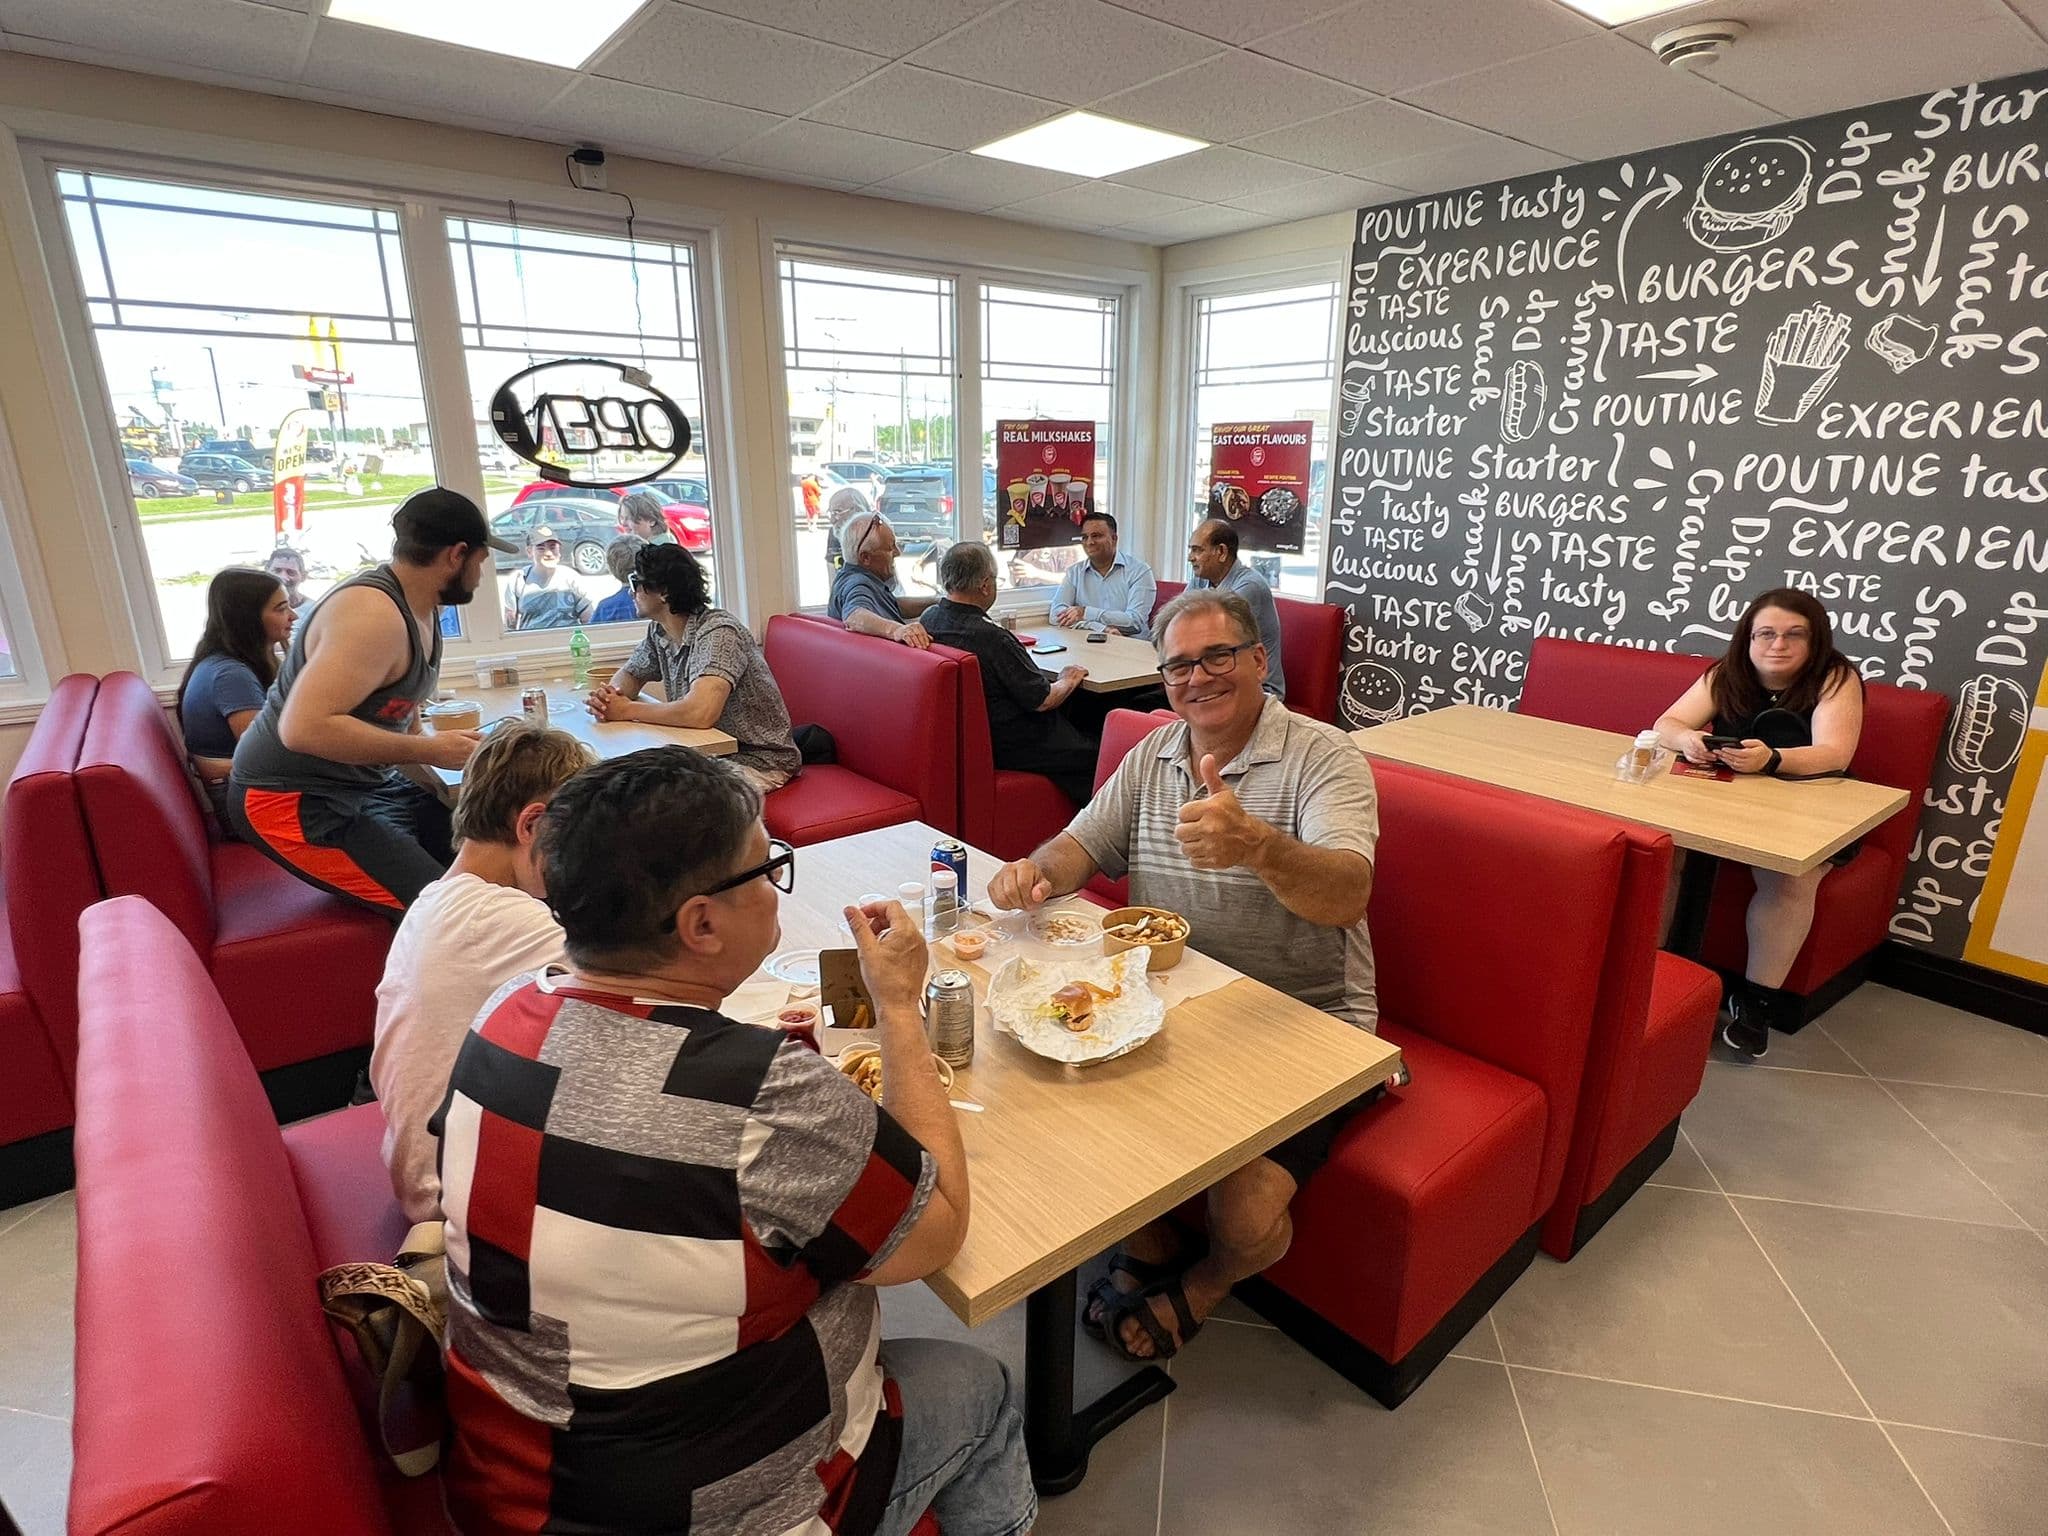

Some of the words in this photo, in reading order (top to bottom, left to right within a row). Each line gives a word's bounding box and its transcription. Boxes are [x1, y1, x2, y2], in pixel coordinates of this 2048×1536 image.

[1914, 83, 2048, 139] Star
[1817, 121, 1892, 204] Dip
[1361, 190, 1484, 244] POUTINE
[1498, 175, 1585, 229] tasty
[1855, 147, 1936, 307] Snack
[1397, 229, 1600, 290] EXPERIENCE
[1638, 240, 1860, 306] BURGERS
[1348, 261, 1378, 317] Dip
[1378, 287, 1450, 324] TASTE
[1940, 204, 2030, 368] Snack
[1347, 323, 1464, 356] luscious
[1511, 289, 1558, 351] Dip
[1615, 313, 1739, 363] TASTE
[1469, 296, 1510, 411] Snack
[1549, 280, 1615, 435] Craving
[1383, 364, 1461, 401] TASTE
[1593, 388, 1742, 427] POUTINE
[1003, 431, 1029, 442] REAL
[1031, 431, 1092, 443] MILKSHAKES
[1213, 434, 1233, 446] EAST
[1233, 434, 1261, 445] COAST
[1262, 433, 1307, 445] FLAVOURS
[1365, 404, 1467, 437] Starter
[1816, 398, 2048, 440] EXPERIEN
[277, 453, 305, 472] OPEN
[1341, 447, 1454, 480] POUTINE
[1468, 443, 1600, 482] Starter
[1734, 452, 1941, 496] POUTINE
[1960, 453, 2048, 503] tas
[1332, 486, 1365, 536] Dip
[1381, 490, 1449, 539] tasty
[1495, 491, 1630, 527] BURGERS
[1363, 526, 1424, 553] TASTE
[1451, 483, 1490, 589] Snack
[1549, 532, 1656, 571] TASTE
[1646, 468, 1725, 623] Craving
[1708, 517, 1771, 582] Dip
[1787, 517, 2048, 574] EXPERIEN
[1332, 545, 1439, 586] luscious
[1500, 530, 1542, 637] Snack
[1783, 569, 1882, 602] TASTE
[1372, 594, 1452, 630] TASTE
[1540, 568, 1626, 626] tasty
[1347, 626, 1441, 665] Starter
[1896, 586, 1967, 690] Snac
[1975, 591, 2048, 666] Dip
[1888, 877, 1963, 943] Dip
